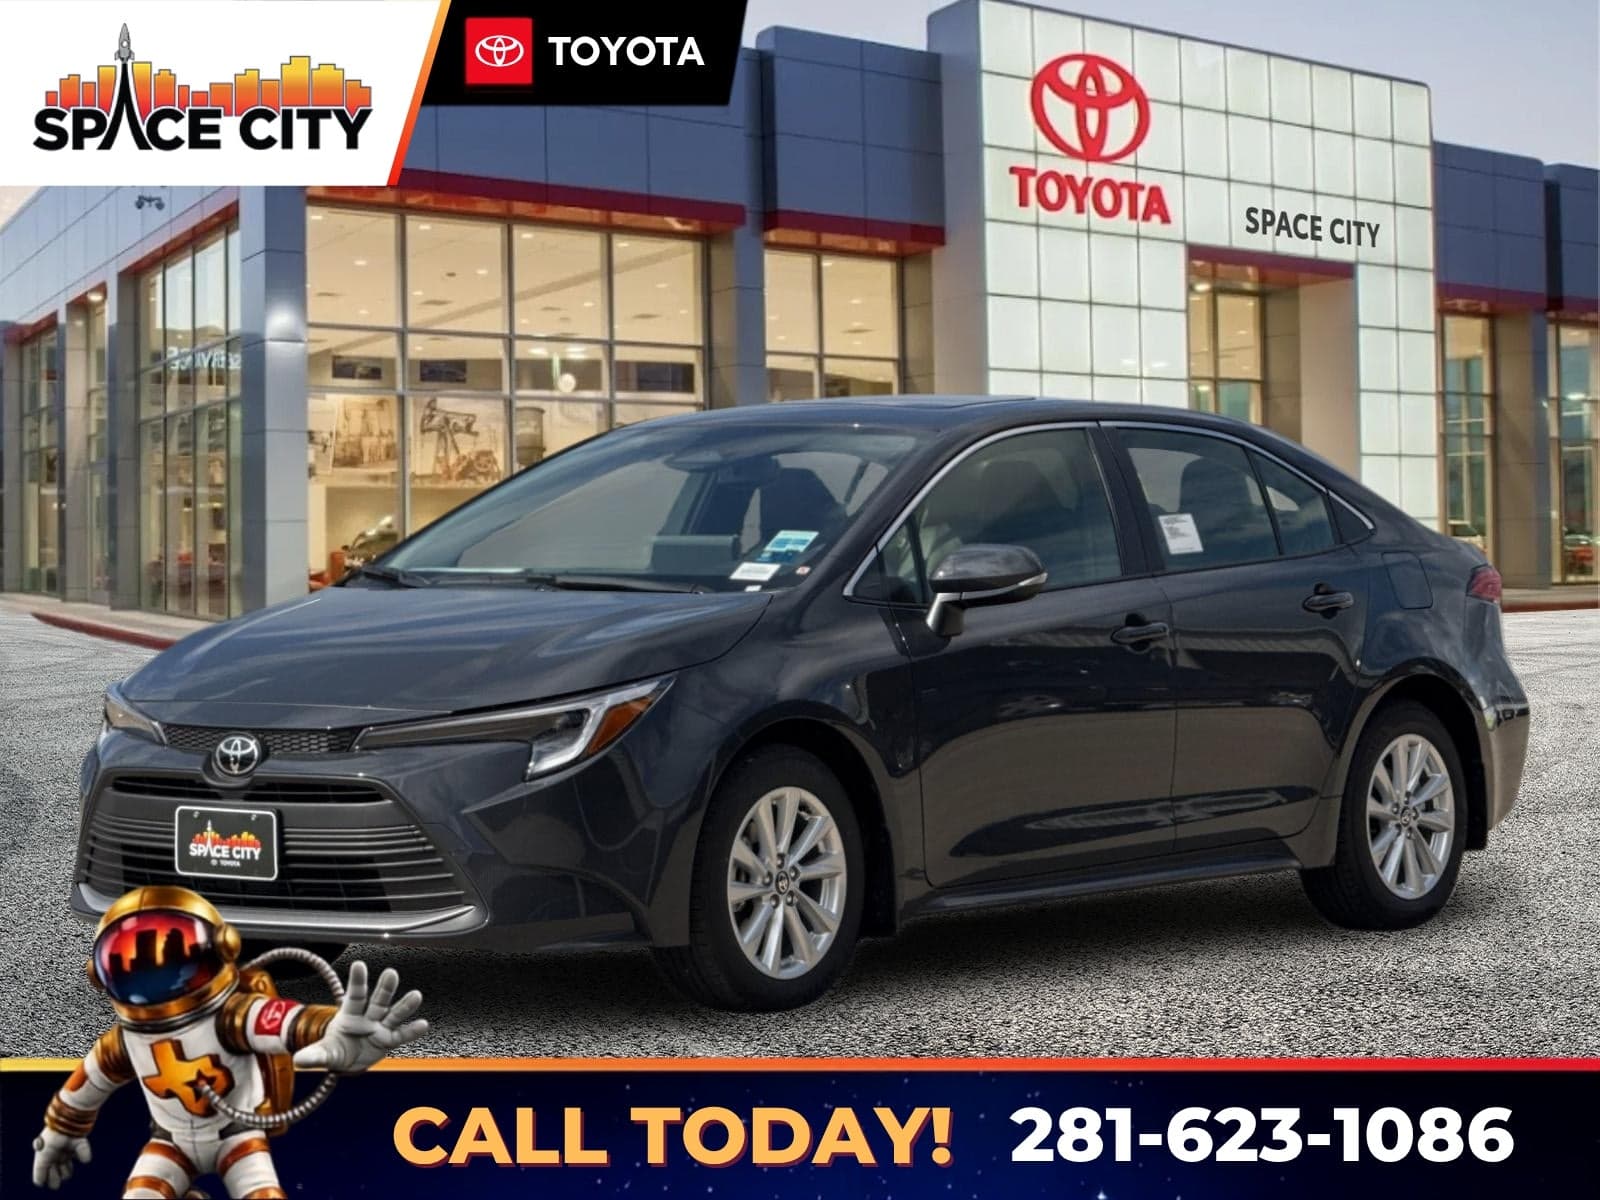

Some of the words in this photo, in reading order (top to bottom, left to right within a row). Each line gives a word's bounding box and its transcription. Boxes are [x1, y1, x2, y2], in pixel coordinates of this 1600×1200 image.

[1010, 166, 1171, 224] TOYOTA
[1245, 206, 1323, 242] SPACE
[1329, 217, 1381, 248] CITY
[232, 846, 262, 860] CITY
